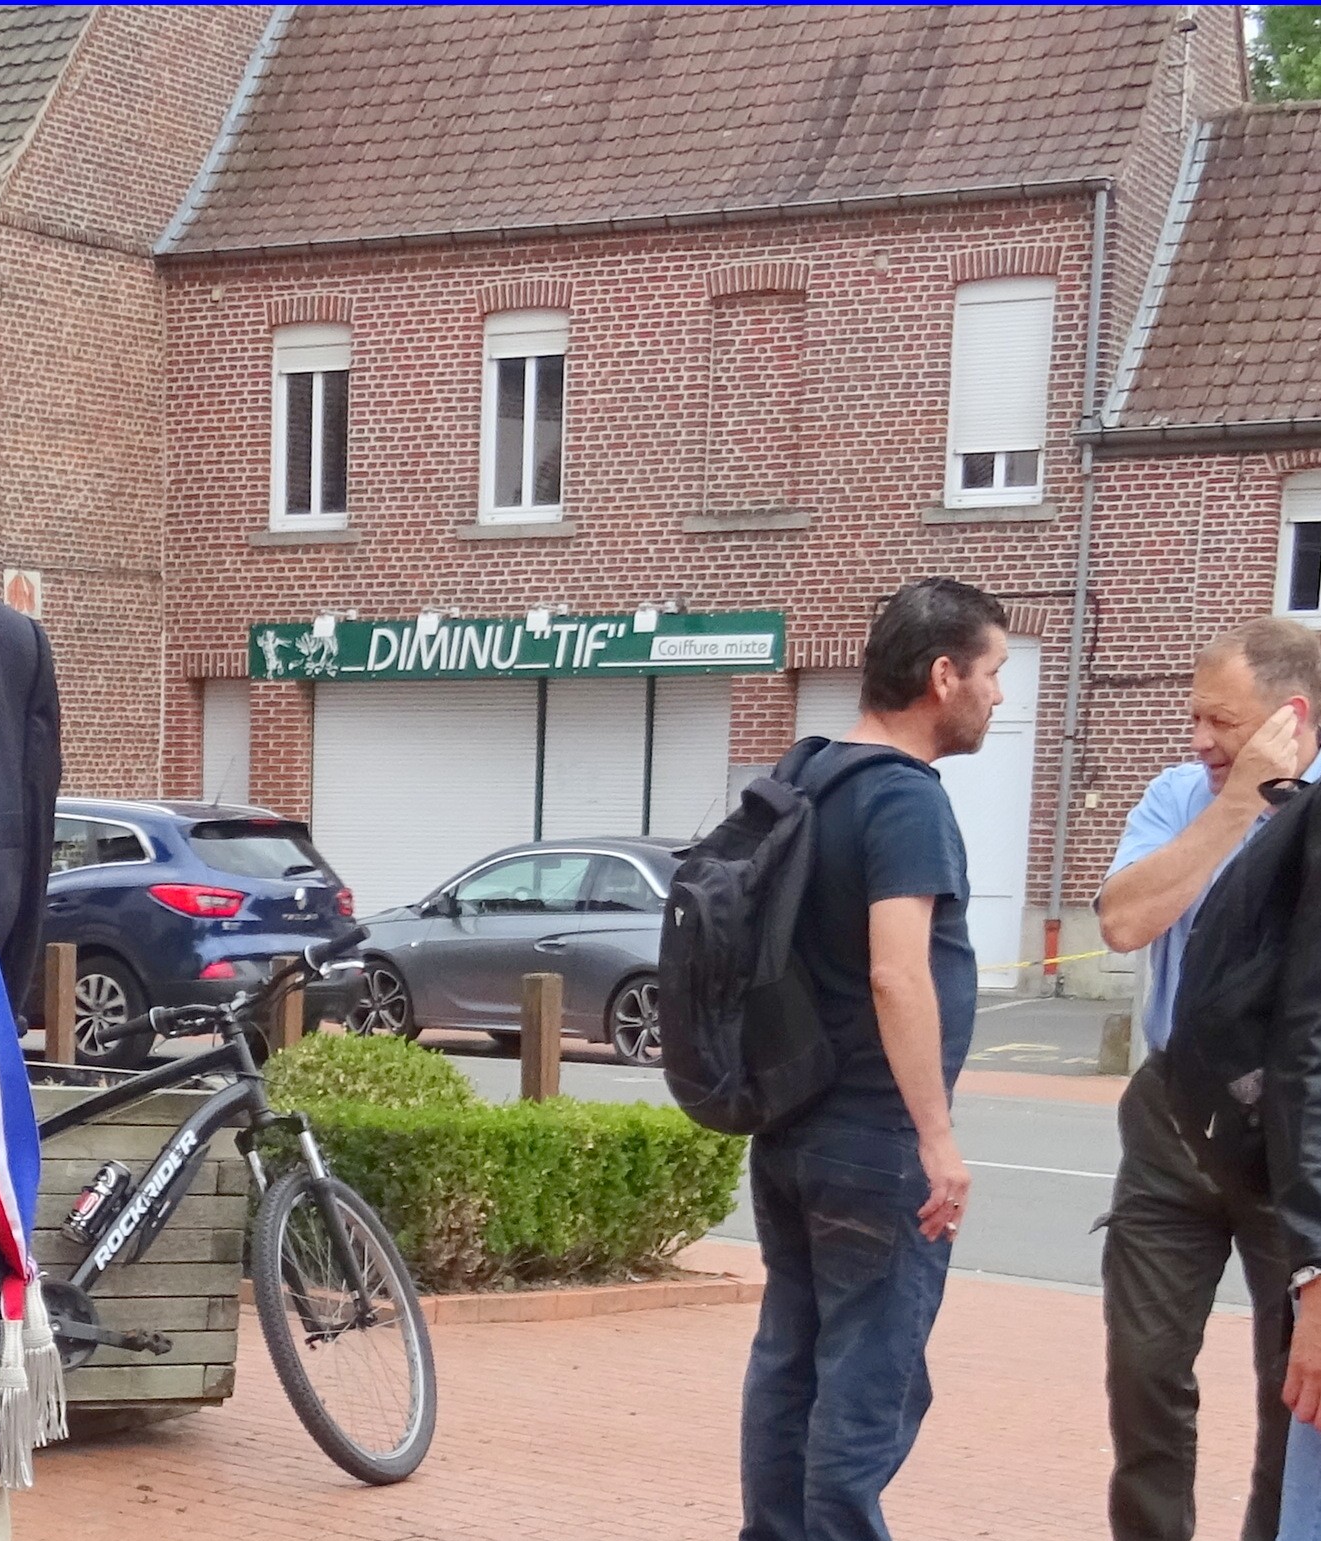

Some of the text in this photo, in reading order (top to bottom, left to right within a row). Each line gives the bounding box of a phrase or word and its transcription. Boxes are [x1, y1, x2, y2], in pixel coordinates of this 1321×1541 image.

[367, 625, 522, 670] DIMINU
[658, 640, 768, 655] Coiffure mixte
[94, 1129, 198, 1271] ROCKRIDER
